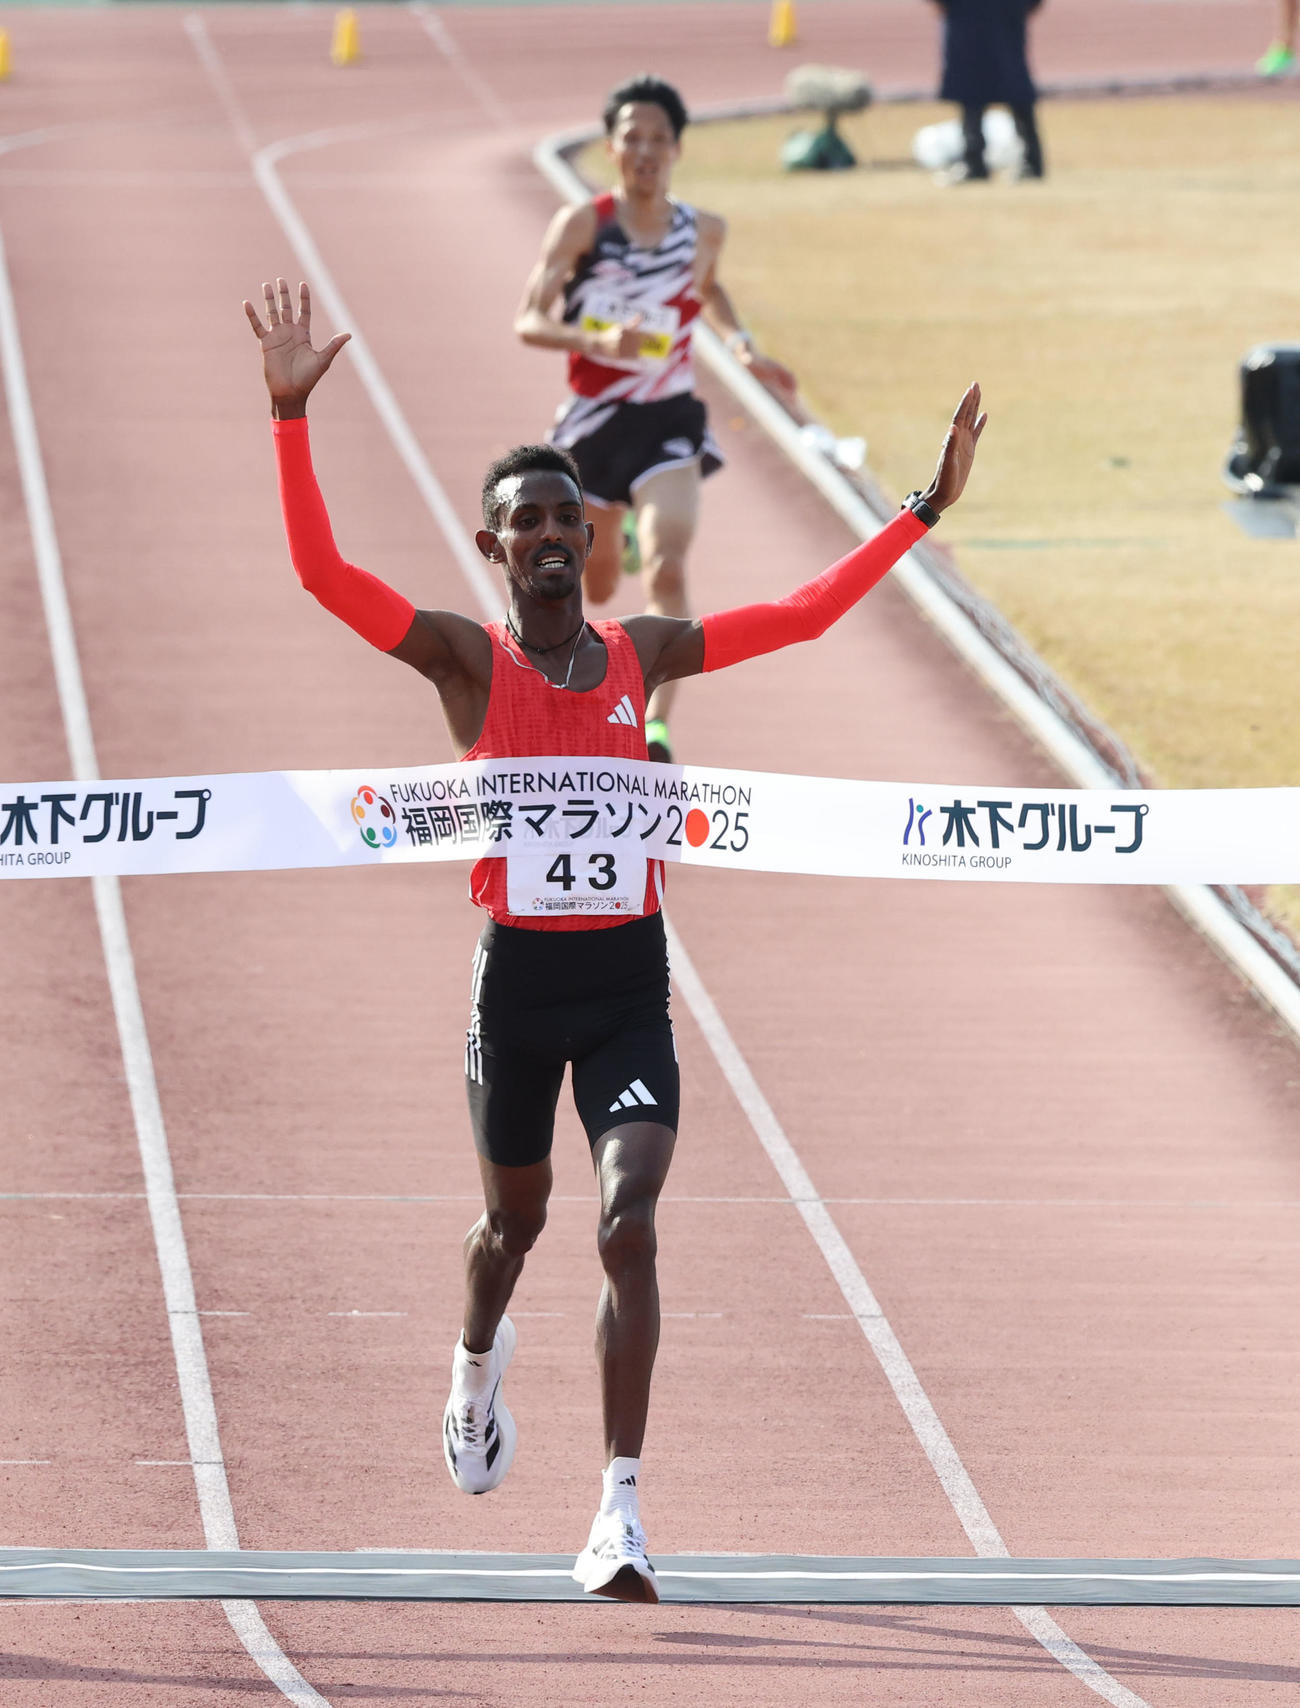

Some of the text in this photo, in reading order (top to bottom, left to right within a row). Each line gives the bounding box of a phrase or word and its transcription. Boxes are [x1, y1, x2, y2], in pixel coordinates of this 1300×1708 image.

[389, 771, 752, 806] FUKUOKA INTERNATIONAL MARATHON
[0, 788, 212, 846] 木下グループ
[939, 799, 1149, 854] 木下グループ
[27, 851, 71, 865] GROUP
[901, 852, 1012, 869] KINOSHITA GROUP
